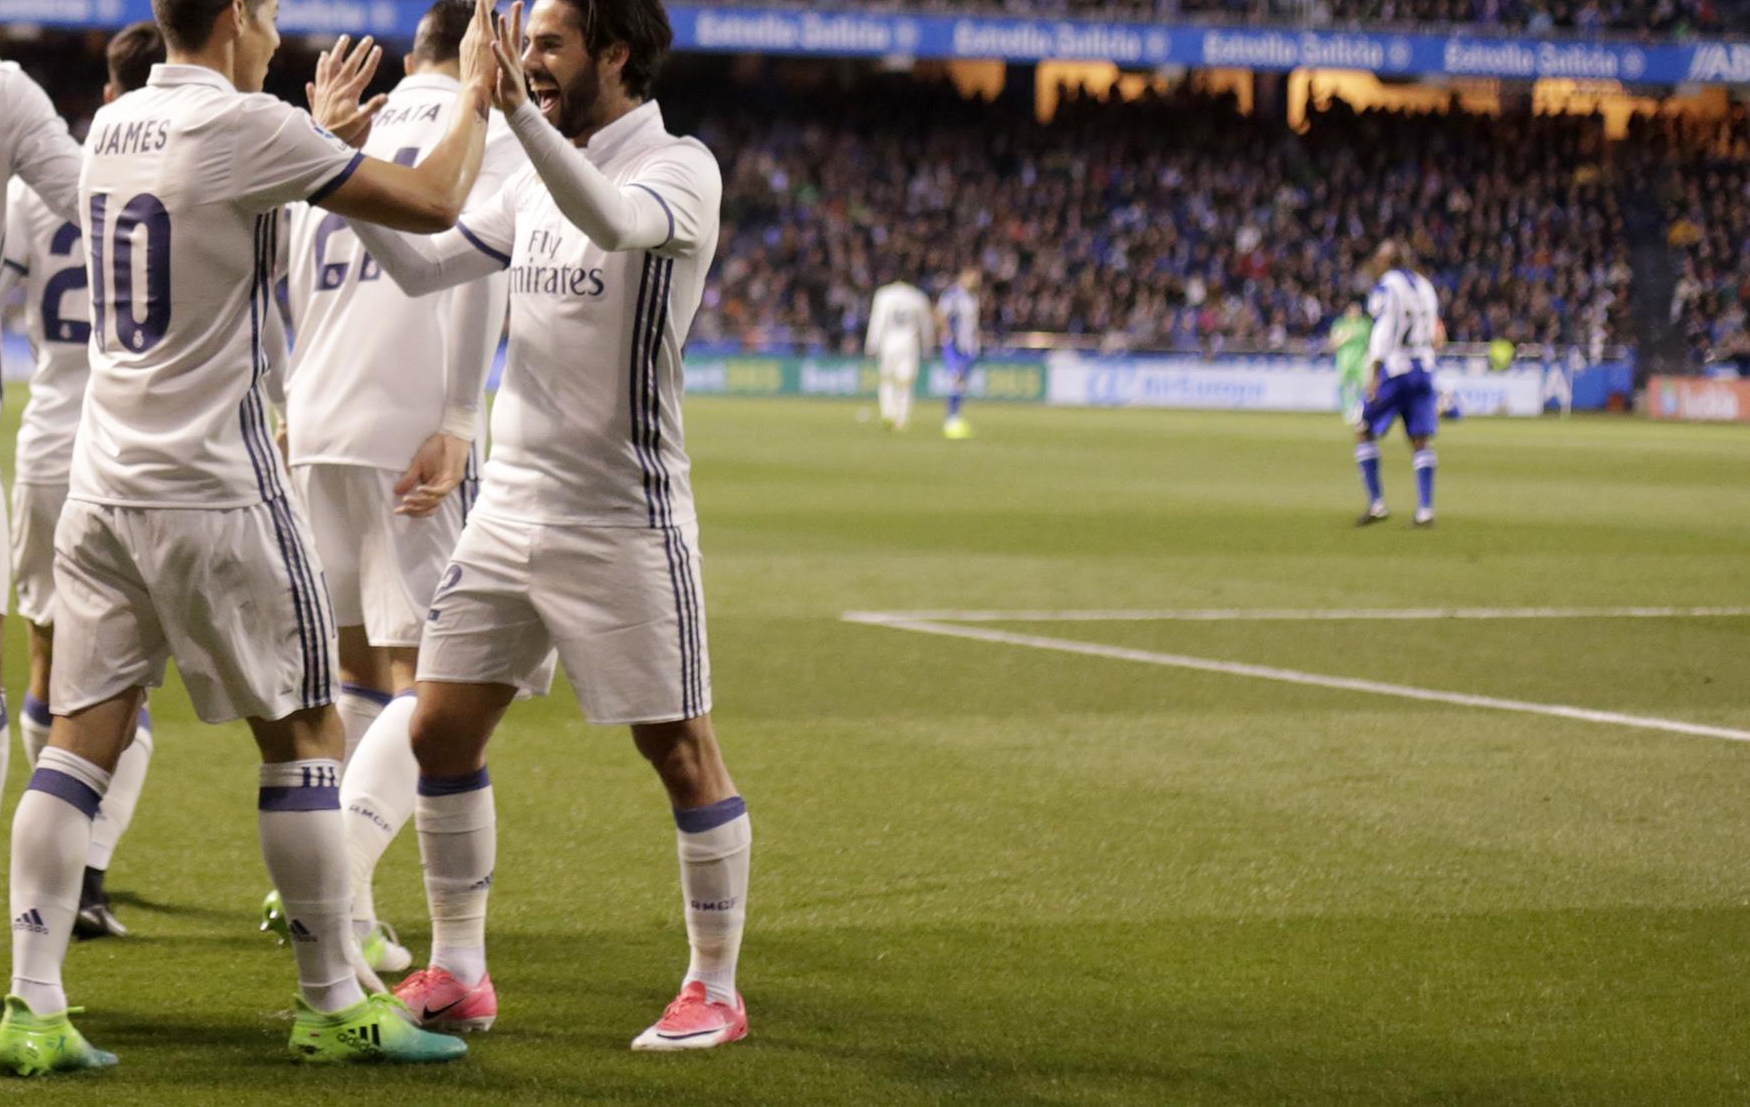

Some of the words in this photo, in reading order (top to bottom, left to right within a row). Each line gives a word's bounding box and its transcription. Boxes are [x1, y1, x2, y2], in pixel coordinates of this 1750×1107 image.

[375, 103, 441, 127] RATA
[94, 119, 171, 155] JAMES
[528, 229, 562, 257] Fly
[90, 193, 171, 354] 10
[509, 265, 604, 295] mirates
